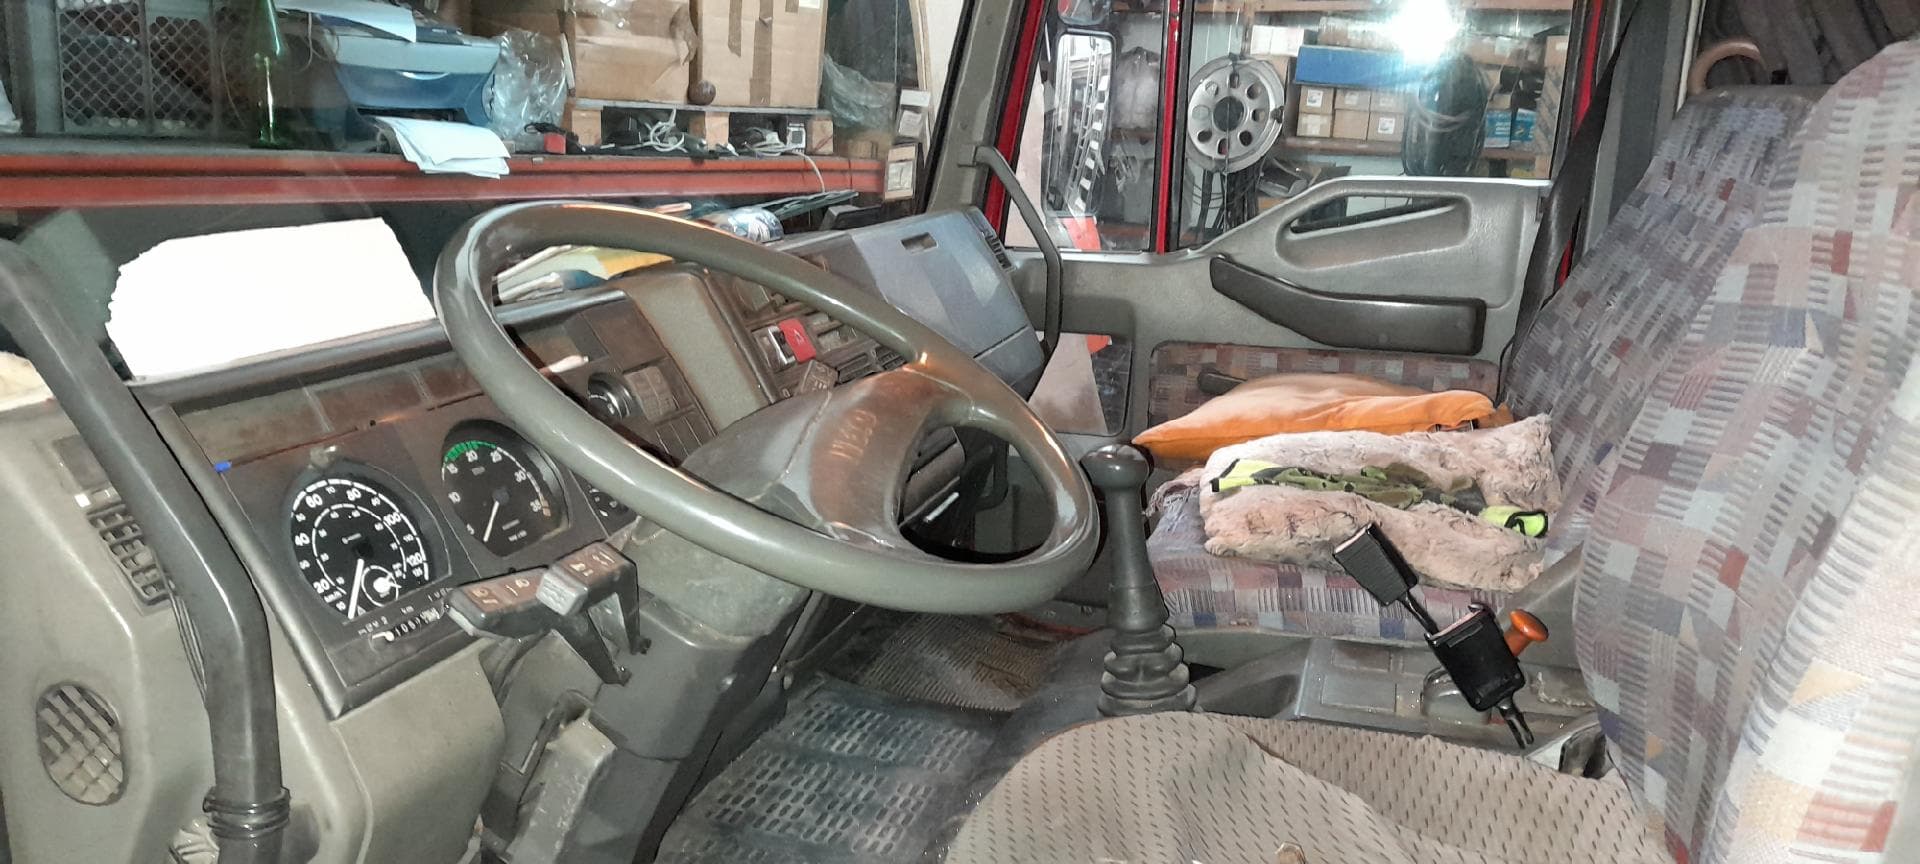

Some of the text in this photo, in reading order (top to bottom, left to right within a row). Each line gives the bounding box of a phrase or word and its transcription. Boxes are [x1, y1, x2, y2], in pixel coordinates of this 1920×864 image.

[466, 449, 478, 462] 20
[446, 463, 458, 474] 15
[514, 469, 527, 482] 30
[325, 485, 336, 495] 70
[346, 488, 362, 501] 80
[305, 493, 323, 508] 60
[448, 492, 461, 504] 10
[529, 499, 541, 512] 35
[383, 512, 401, 526] 100
[294, 532, 310, 547] 40
[406, 552, 424, 567] 120
[313, 578, 330, 594] 20
